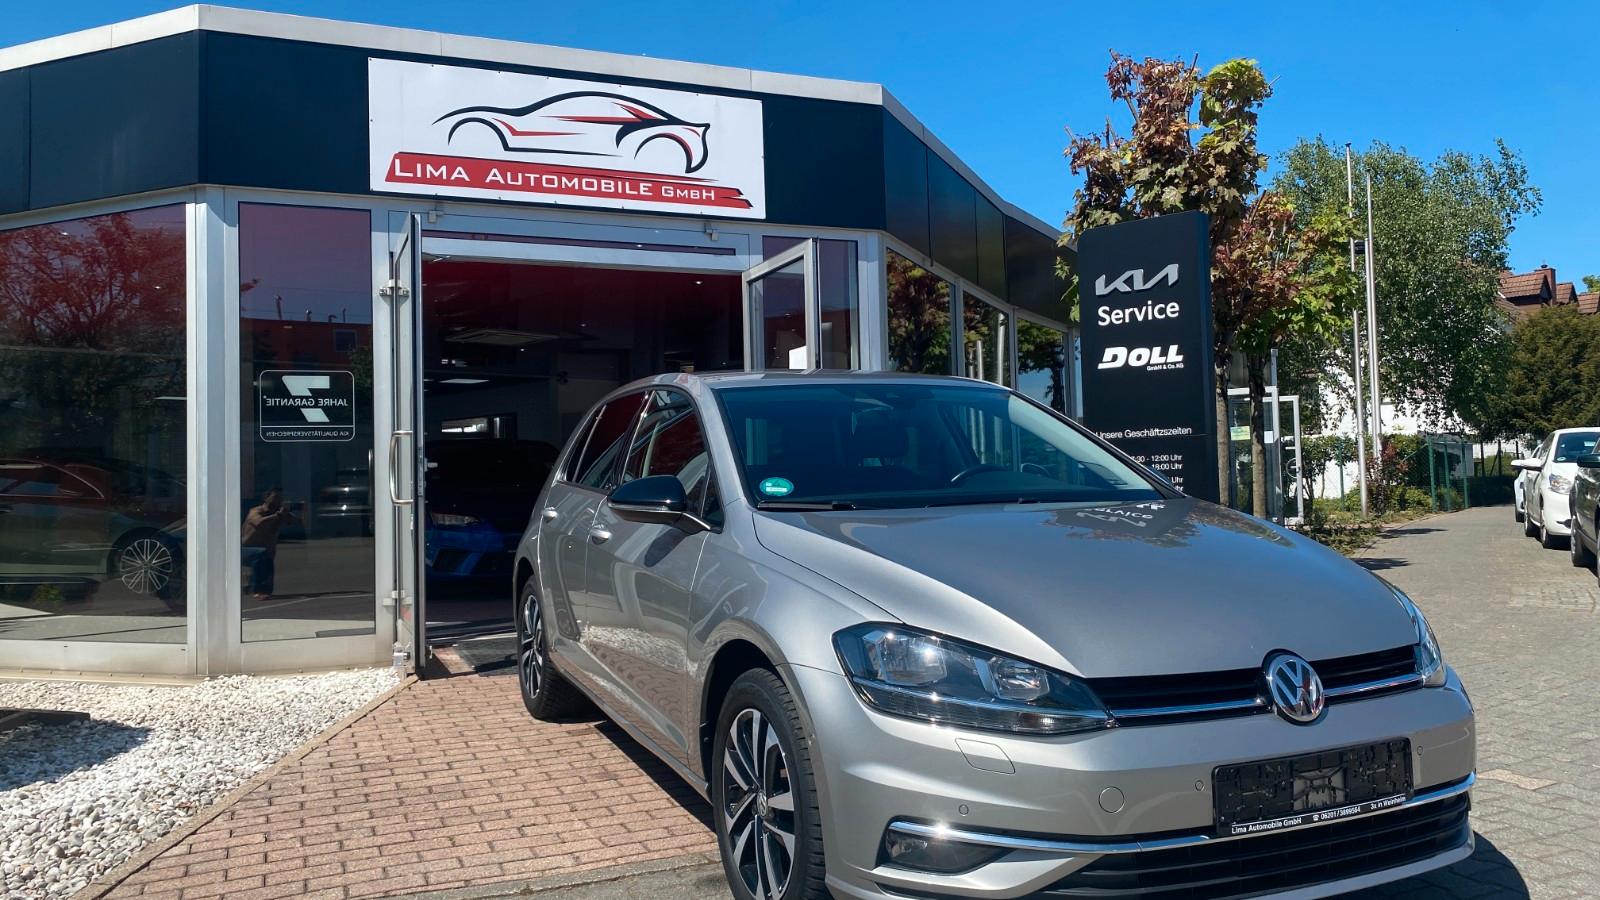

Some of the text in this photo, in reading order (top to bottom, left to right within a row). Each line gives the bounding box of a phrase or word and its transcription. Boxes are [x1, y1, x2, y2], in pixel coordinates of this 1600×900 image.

[1097, 300, 1180, 326] Service
[1097, 344, 1184, 369] DOLL
[1125, 427, 1192, 438] Geschäftzszeiten
[1151, 454, 1169, 462] 12:00
[1170, 453, 1182, 461] Uhr
[1170, 462, 1182, 470] Uhr
[1171, 476, 1183, 484] Uhr
[1248, 821, 1282, 832] Automobile
[1283, 817, 1302, 826] GmbH
